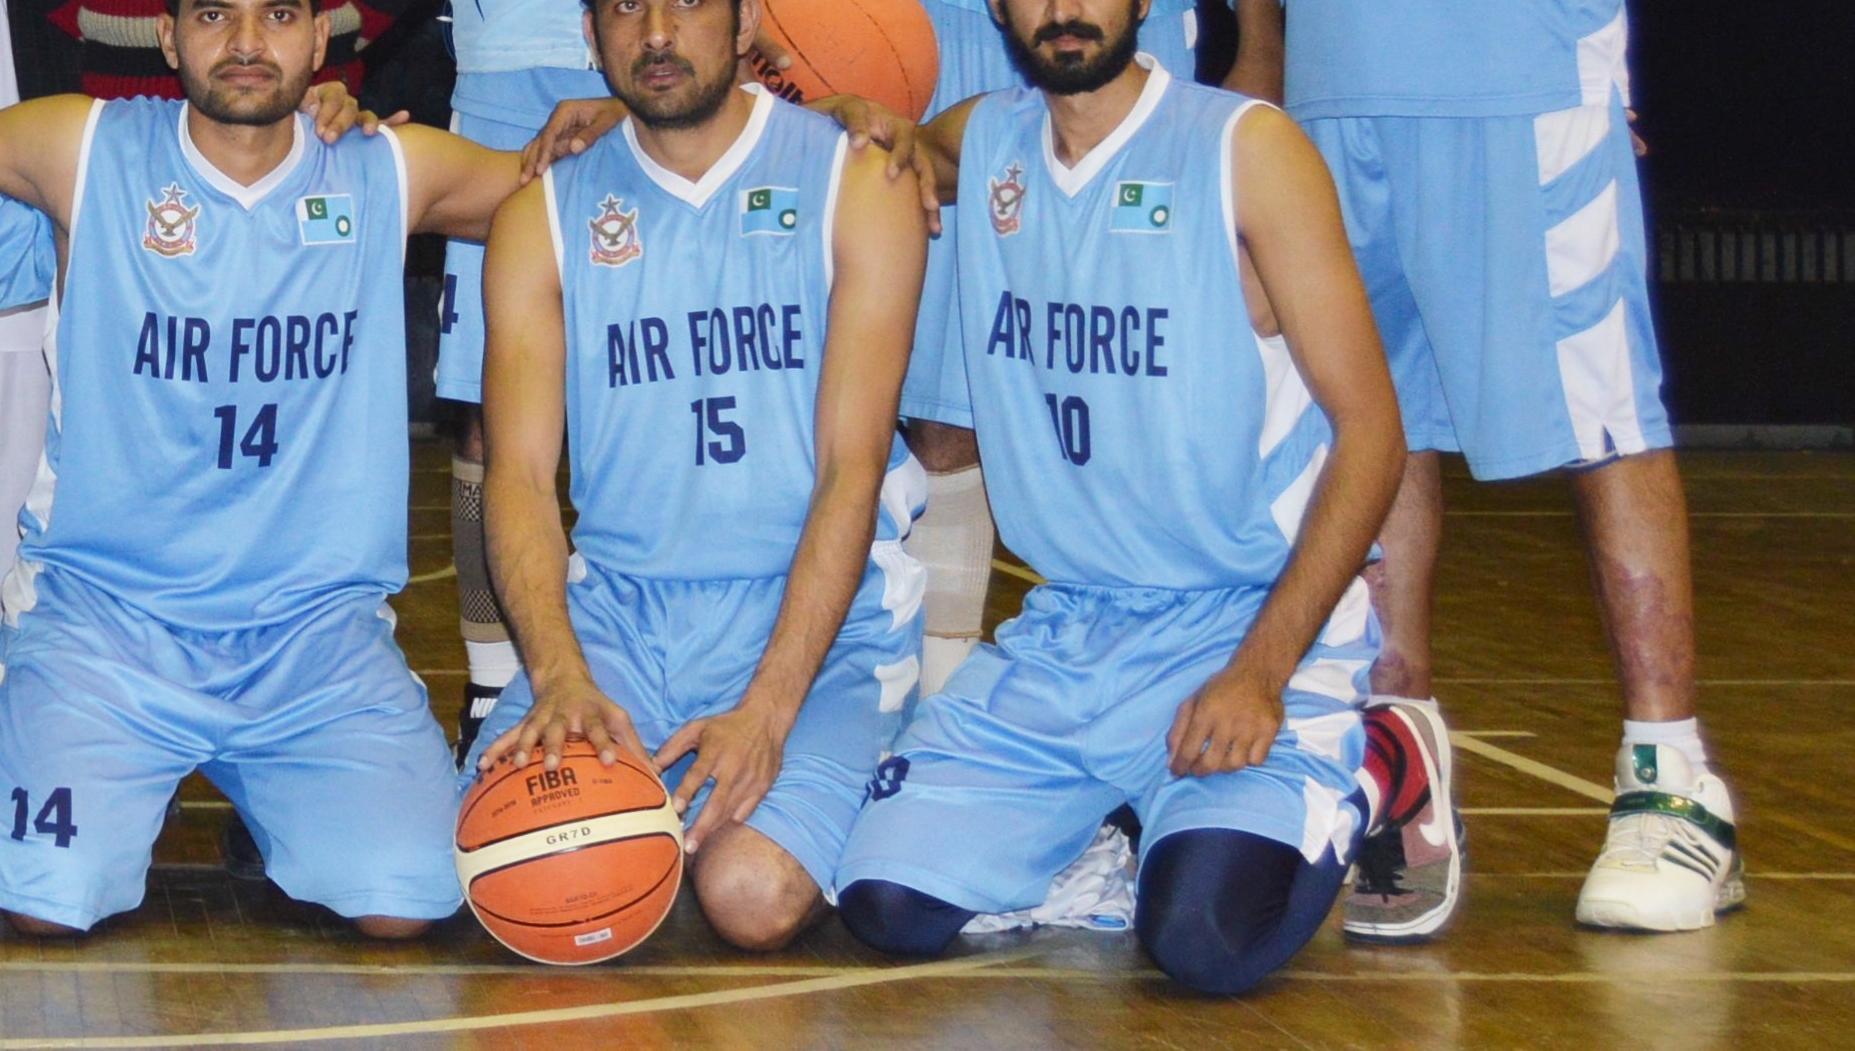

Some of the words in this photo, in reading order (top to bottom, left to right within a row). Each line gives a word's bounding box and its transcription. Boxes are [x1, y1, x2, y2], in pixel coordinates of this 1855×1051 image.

[133, 311, 211, 383] AIR
[229, 309, 358, 383] FORCE
[607, 317, 674, 389] AIR
[688, 302, 805, 377] FORCE
[1046, 301, 1169, 377] FORCE
[213, 403, 279, 470] 14
[690, 395, 746, 467] 15
[1044, 392, 1091, 467] 10
[525, 766, 577, 796] FIBA
[530, 787, 580, 807] APPROVED
[10, 786, 78, 849] 14
